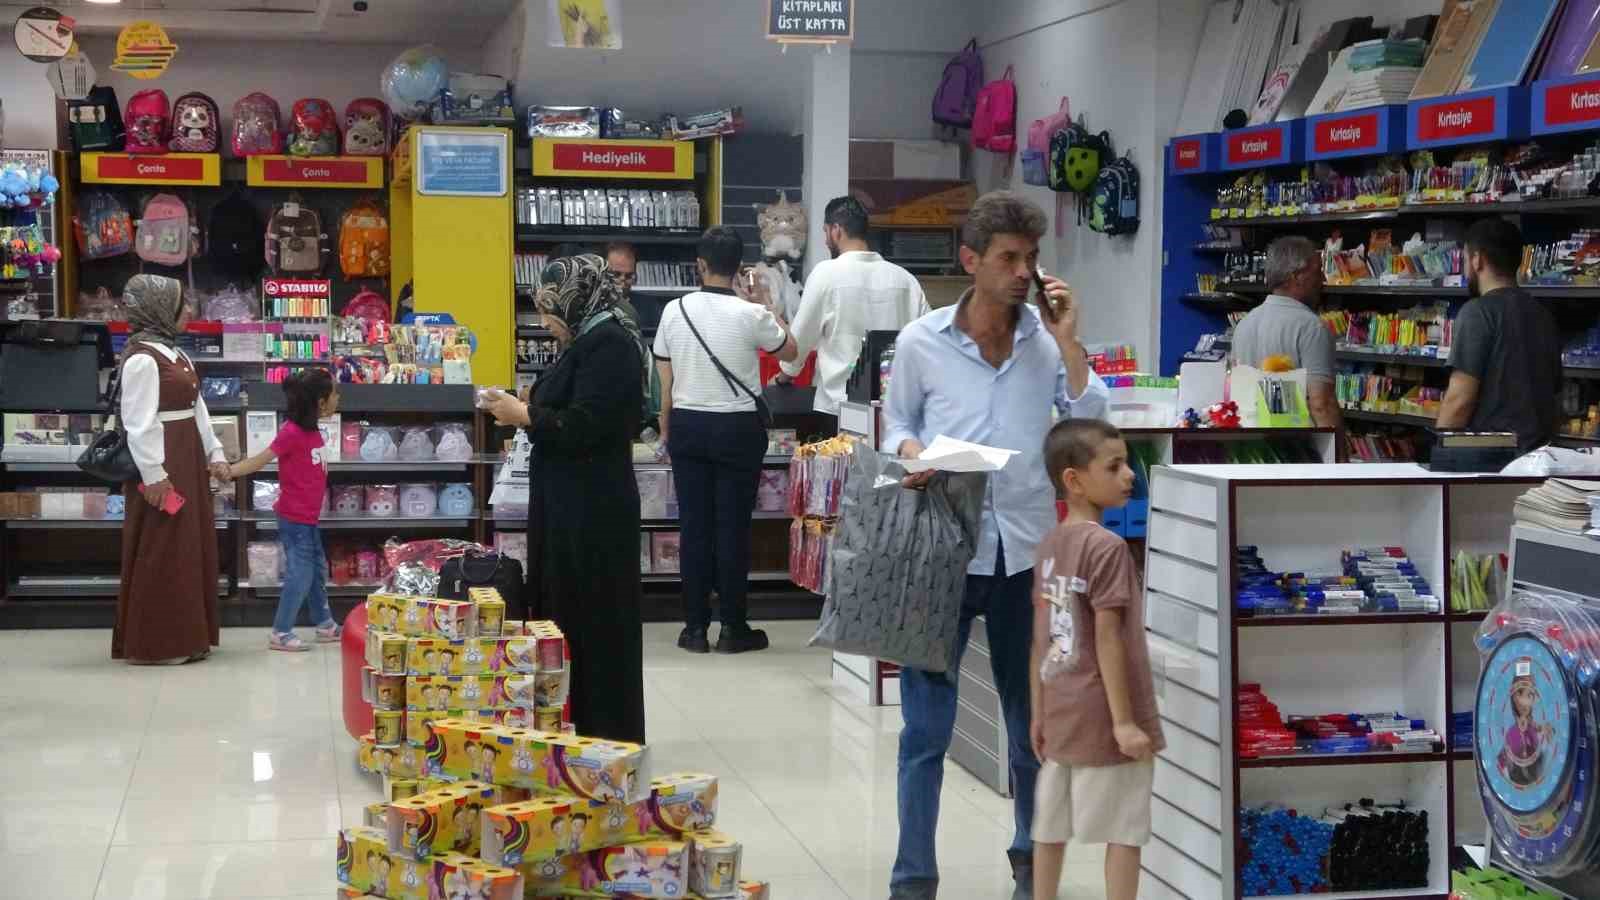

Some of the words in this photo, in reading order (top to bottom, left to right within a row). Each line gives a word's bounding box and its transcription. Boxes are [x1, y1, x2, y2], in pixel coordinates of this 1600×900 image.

[778, 15, 802, 30] ÜST
[806, 18, 845, 31] KATTA
[1438, 108, 1472, 129] Kırtasiye
[1330, 125, 1361, 143] Kırtasiye
[582, 151, 647, 167] Hediyelik
[137, 163, 166, 175] Çanta
[302, 167, 330, 178] Çanta
[280, 283, 328, 294] STABILO
